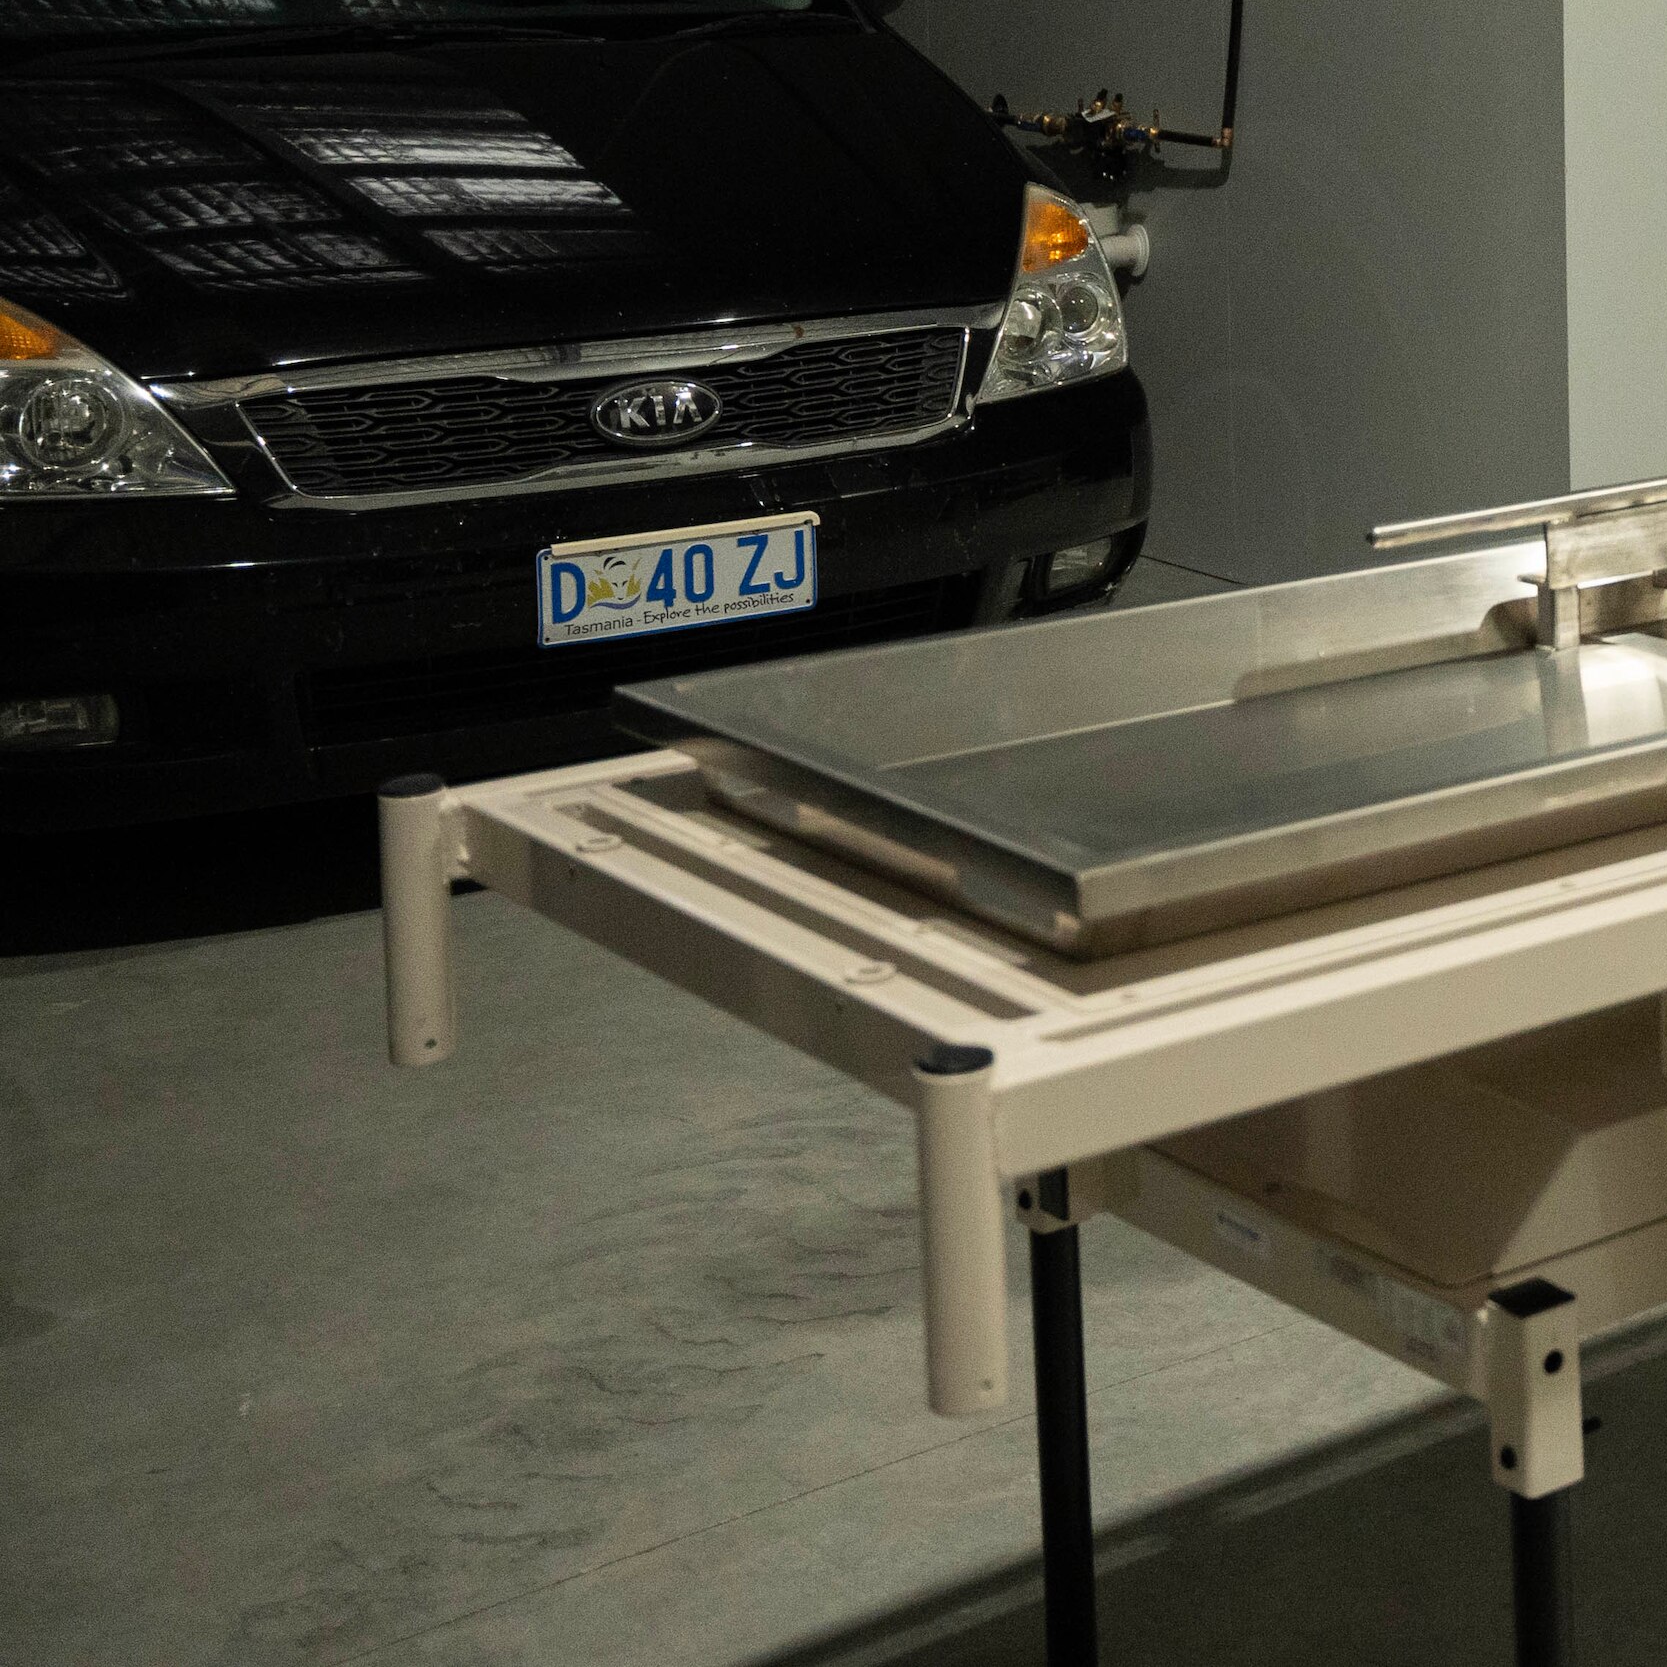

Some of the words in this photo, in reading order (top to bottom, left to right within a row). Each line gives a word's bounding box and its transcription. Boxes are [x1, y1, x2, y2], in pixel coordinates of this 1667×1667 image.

[614, 386, 703, 429] KIA
[550, 561, 586, 625] D
[646, 543, 715, 608] 40
[737, 529, 805, 596] ZJ
[564, 616, 634, 636] Tasmania
[643, 606, 691, 625] Explore
[695, 602, 720, 616] the
[724, 592, 794, 614] possibilities
